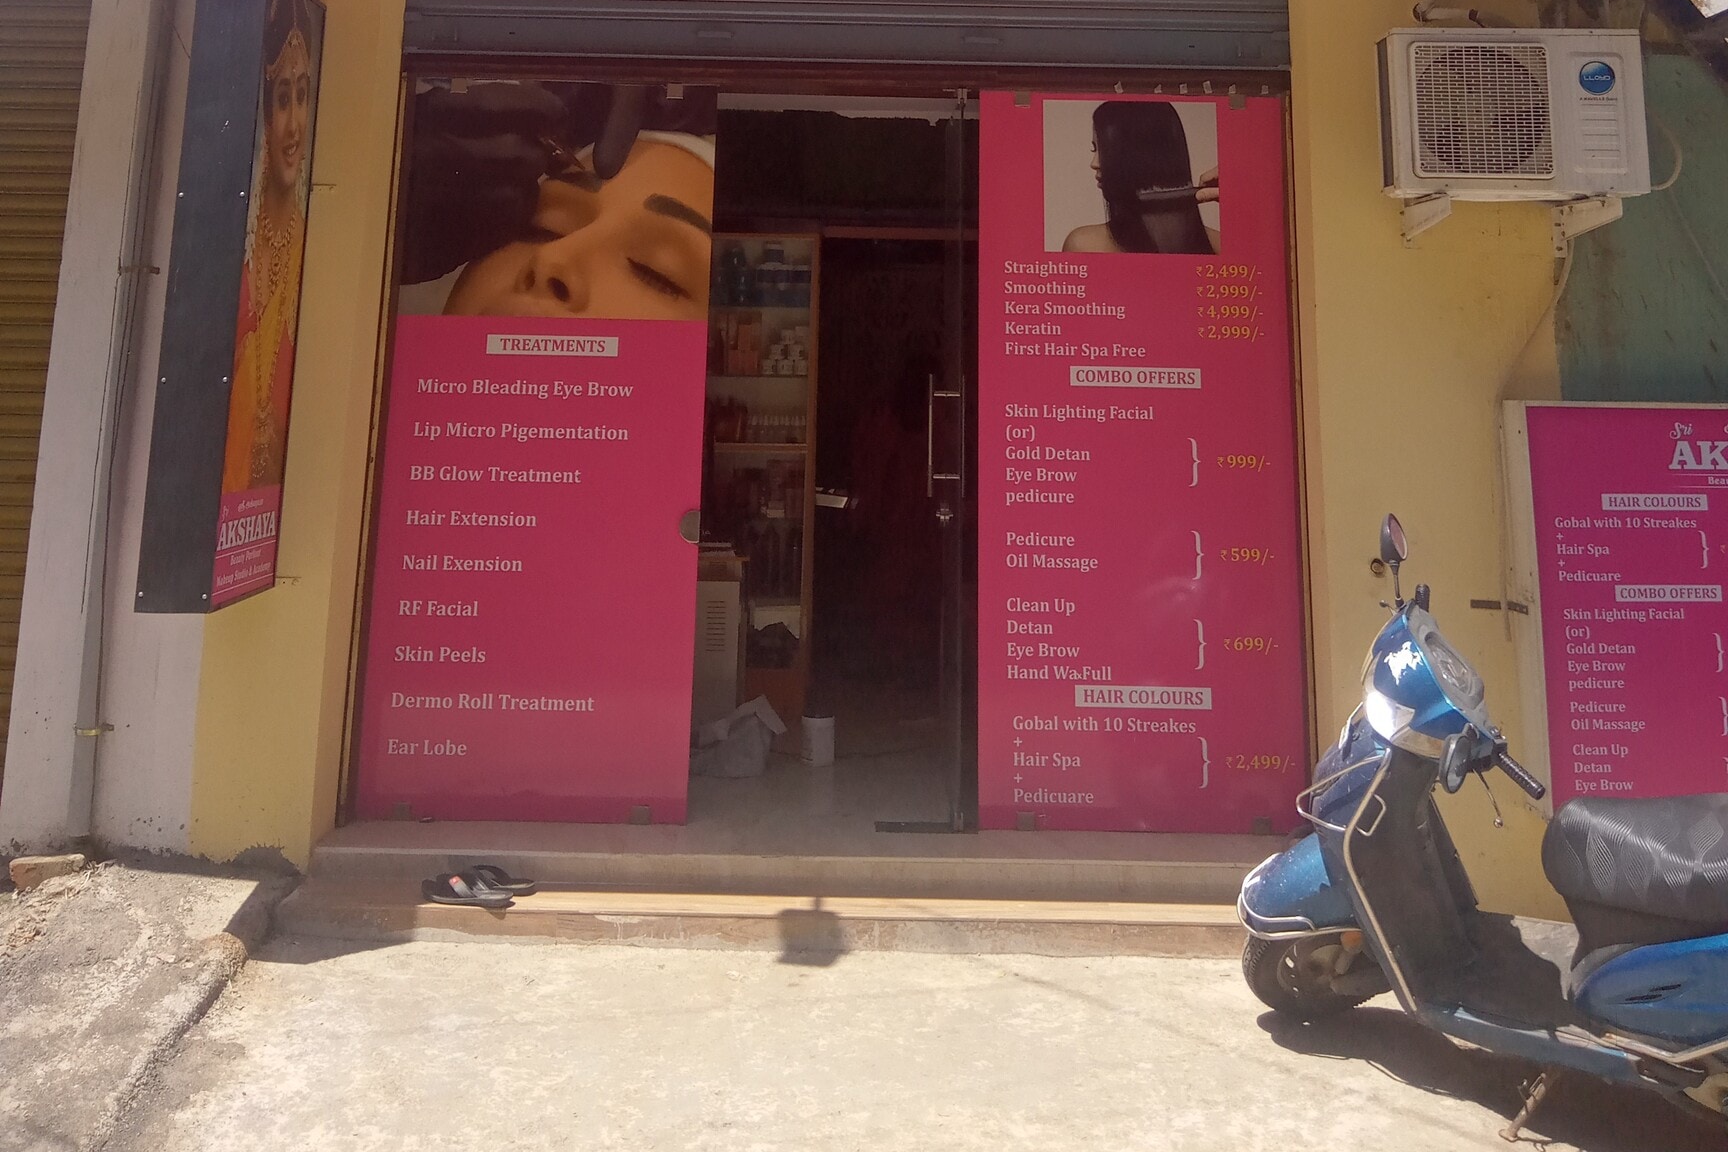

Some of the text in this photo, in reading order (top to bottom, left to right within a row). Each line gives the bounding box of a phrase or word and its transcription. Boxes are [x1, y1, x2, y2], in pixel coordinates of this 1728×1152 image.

[1004, 261, 1088, 278] Straighting
[1004, 281, 1086, 297] Smoothing
[1004, 301, 1126, 318] Kera Smoothing
[1004, 322, 1061, 335] Keratin
[500, 338, 606, 354] TREATMENTS
[1004, 342, 1146, 359] First Hair Spa Free
[1076, 369, 1195, 385] COMBO OFFERS
[417, 378, 633, 398] Micro Bleading Eye Brow
[1006, 404, 1153, 422] Skin Lighting Facial
[414, 422, 629, 442] Lip Micro Pigementation
[1006, 425, 1036, 443] (or)
[1670, 422, 1694, 439] Sri
[1006, 446, 1090, 461] Gold Detan
[410, 465, 581, 484] BB Glow Treatment
[1006, 468, 1077, 484] Eye Brow
[1006, 489, 1075, 505] pedicure
[1608, 496, 1701, 508] HAIR COLOURS
[406, 510, 537, 528] Hair Extension
[1555, 517, 1697, 529] Gobal with 10 Streakes
[217, 511, 276, 551] AKSHAYA
[1006, 532, 1075, 546] Pedicure
[1557, 544, 1610, 558] Hair Spa
[402, 555, 523, 573] Nail Exension
[1006, 554, 1099, 573] Oil Massage
[1559, 570, 1621, 582] Pedicuare
[1620, 587, 1717, 599] COMBO OFFERS
[398, 600, 478, 617] RF Facial
[1007, 598, 1075, 616] Clean Up
[1564, 608, 1684, 623] Skin Lighting Facial
[1007, 620, 1053, 635] Detan
[1565, 626, 1590, 640] (or)
[394, 646, 486, 663] Skin Peels
[1007, 643, 1079, 660] Eye Brow
[1567, 643, 1635, 654] Gold Detan
[1007, 666, 1049, 680] Hand
[1568, 660, 1626, 674] Eye Brow
[1569, 677, 1625, 691] pedicure
[391, 693, 595, 713] Dermo Roll Treatment
[1083, 690, 1204, 705] HAIR COLOURS
[1570, 701, 1626, 713] Pedicure
[1013, 716, 1196, 733] Gobal with 10 Streakes
[1571, 719, 1645, 734] Oil Massage
[387, 739, 467, 756] Ear Lobe
[1573, 744, 1628, 758] Clean Up
[1013, 753, 1080, 771] Hair Spa
[1574, 762, 1612, 773] Detan
[1575, 779, 1634, 794] Eye Brow
[1013, 789, 1094, 804] Pedicuare
